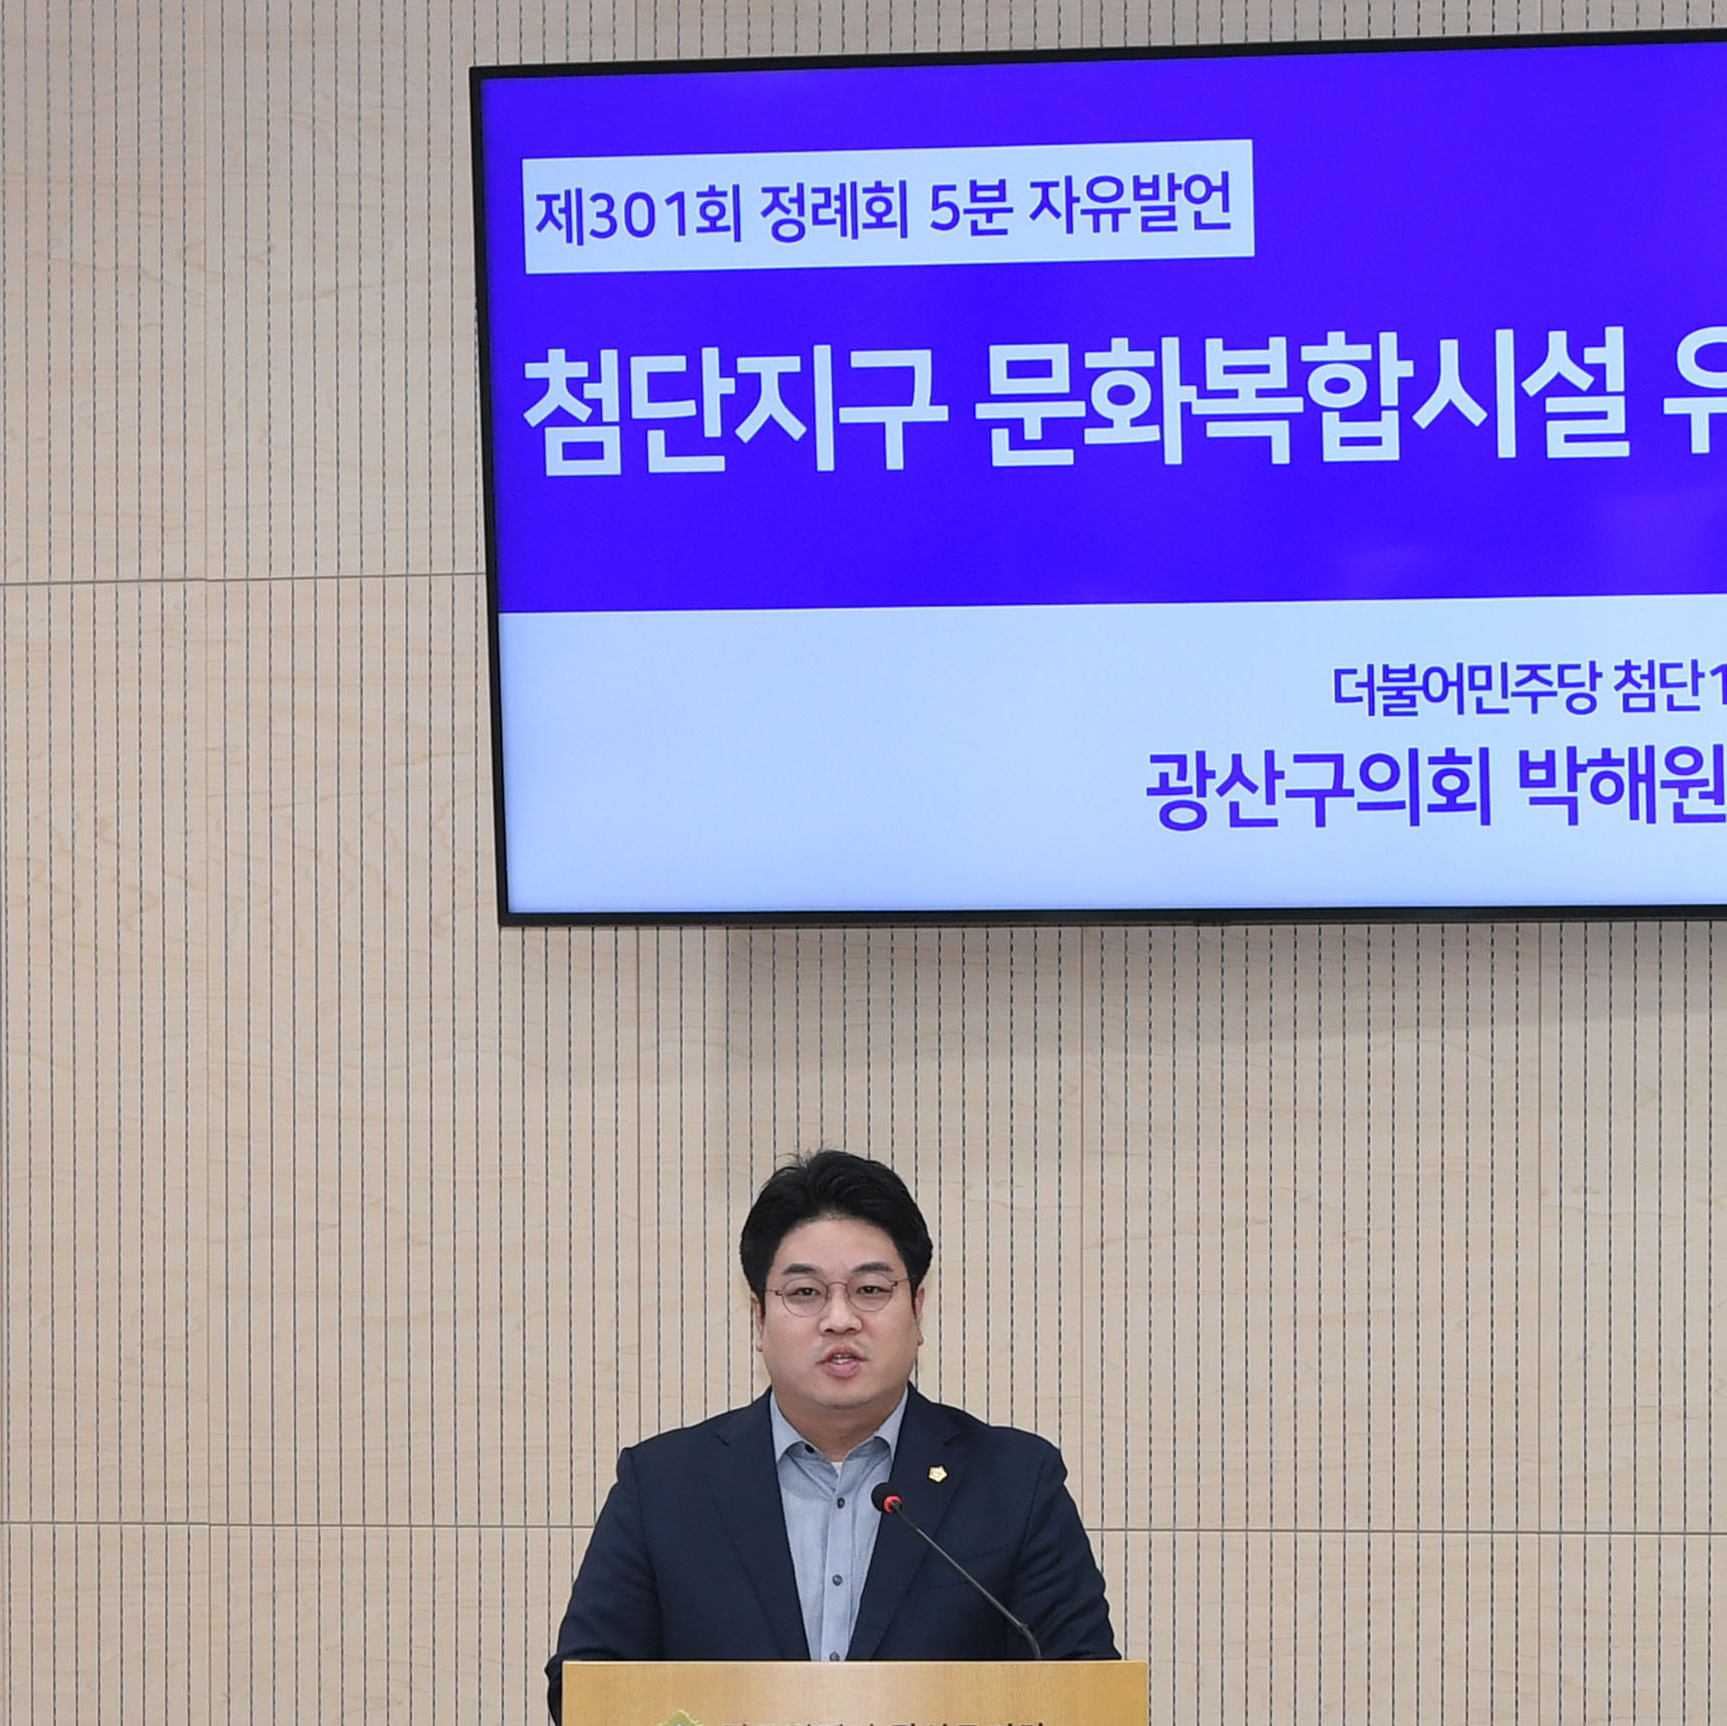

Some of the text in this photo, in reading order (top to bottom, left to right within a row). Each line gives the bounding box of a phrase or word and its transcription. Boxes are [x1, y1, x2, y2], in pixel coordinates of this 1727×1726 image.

[535, 169, 1236, 246] 제301회 정례회 5분 자유발언
[523, 344, 949, 476] 첨단지구
[975, 326, 1630, 467] 문화복합시설
[1332, 660, 1604, 717] 더불어민주당
[1145, 746, 1492, 832] 광산구의회
[1518, 743, 1727, 827] 박해원
